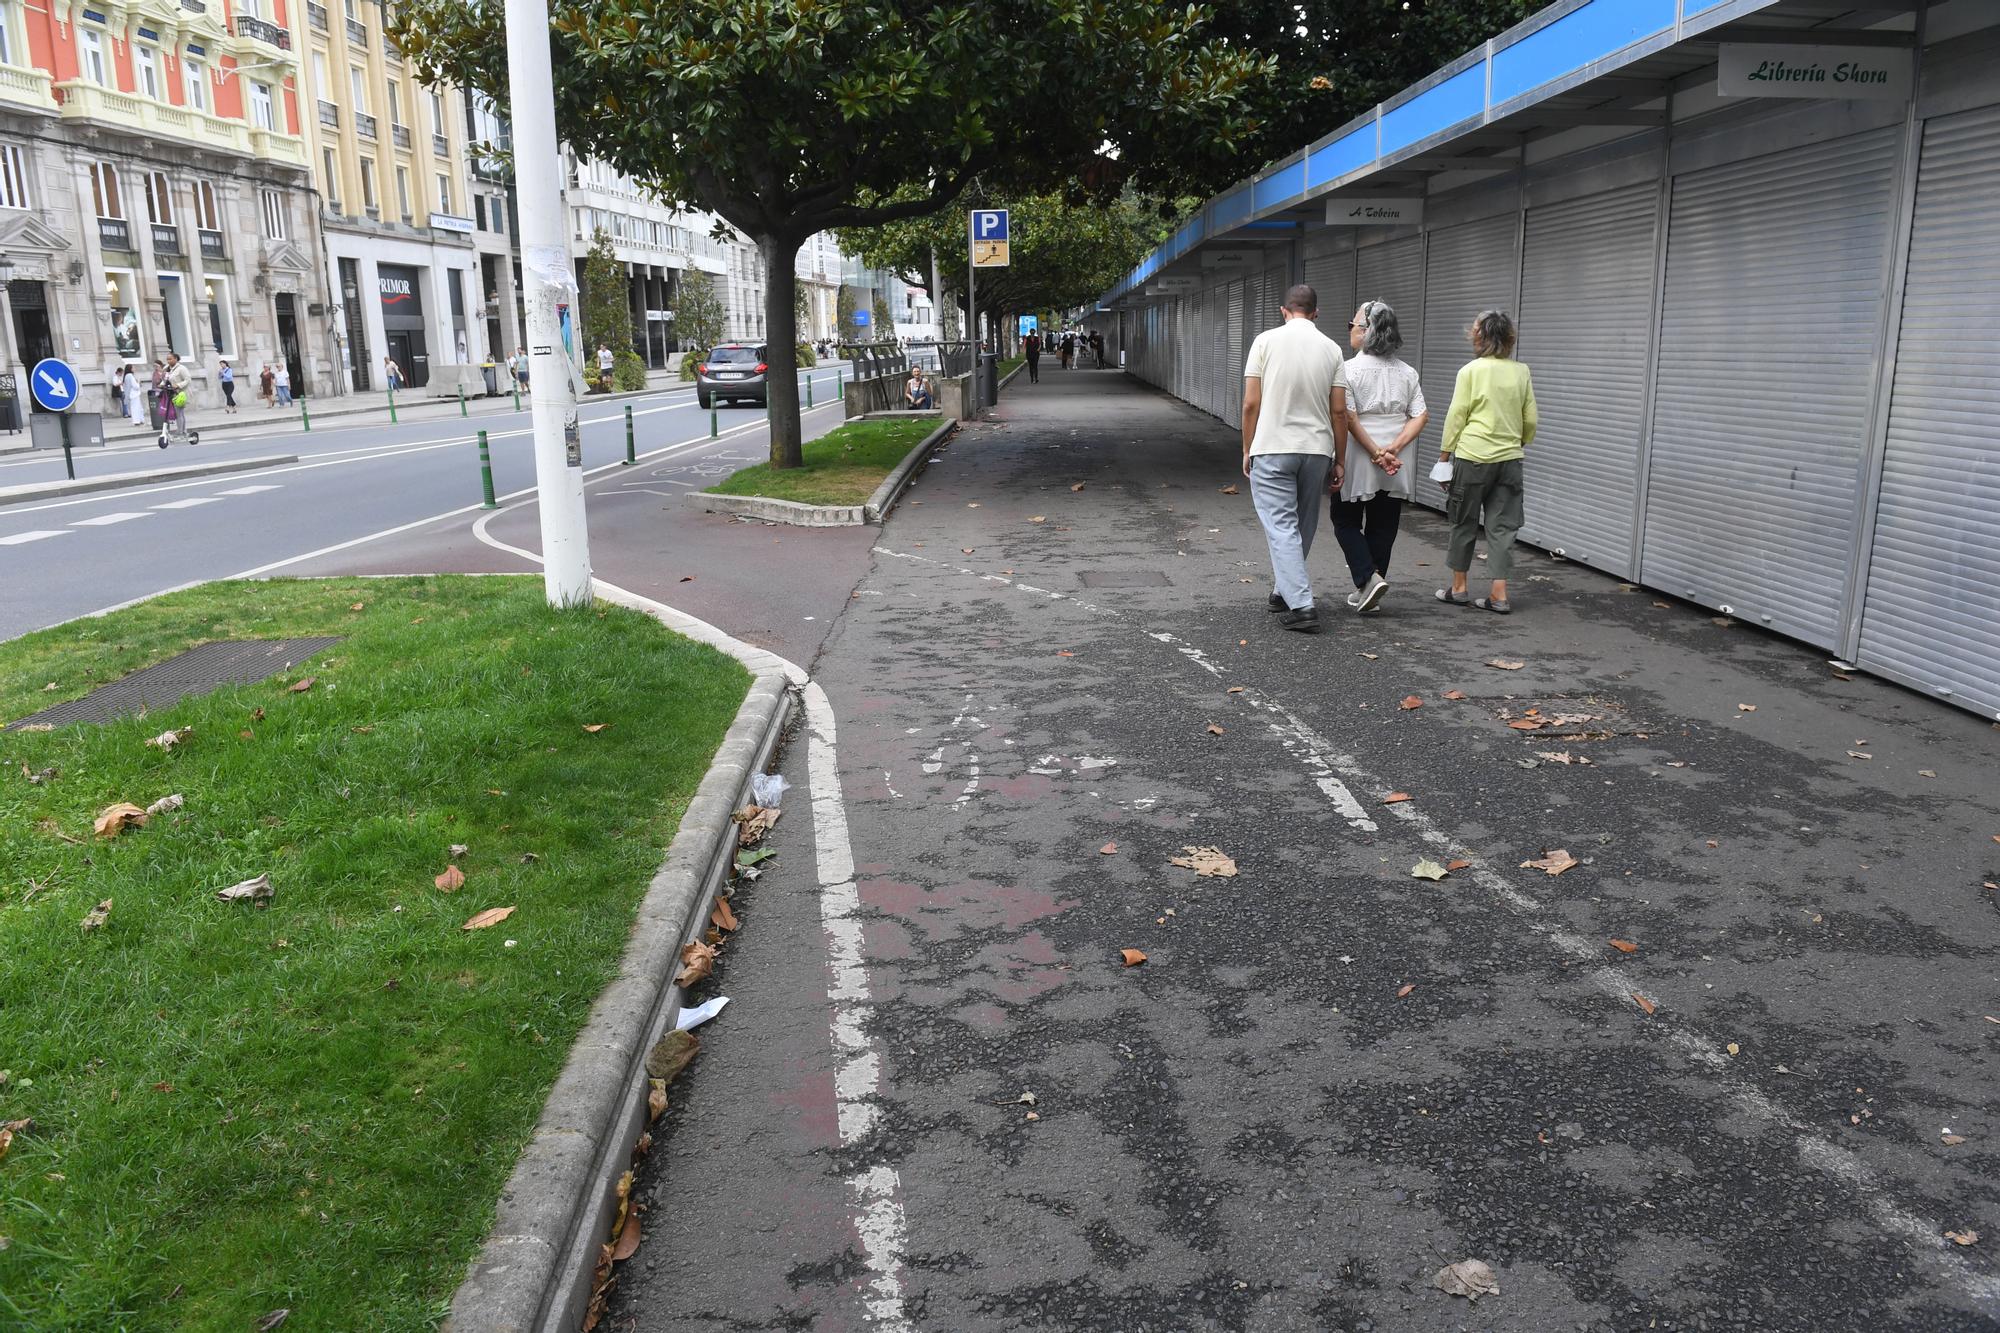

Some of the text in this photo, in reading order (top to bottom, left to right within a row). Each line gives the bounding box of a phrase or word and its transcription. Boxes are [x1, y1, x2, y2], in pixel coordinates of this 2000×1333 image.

[1748, 61, 1888, 84] Librería Shora
[1348, 206, 1362, 217] A
[981, 213, 999, 237] P
